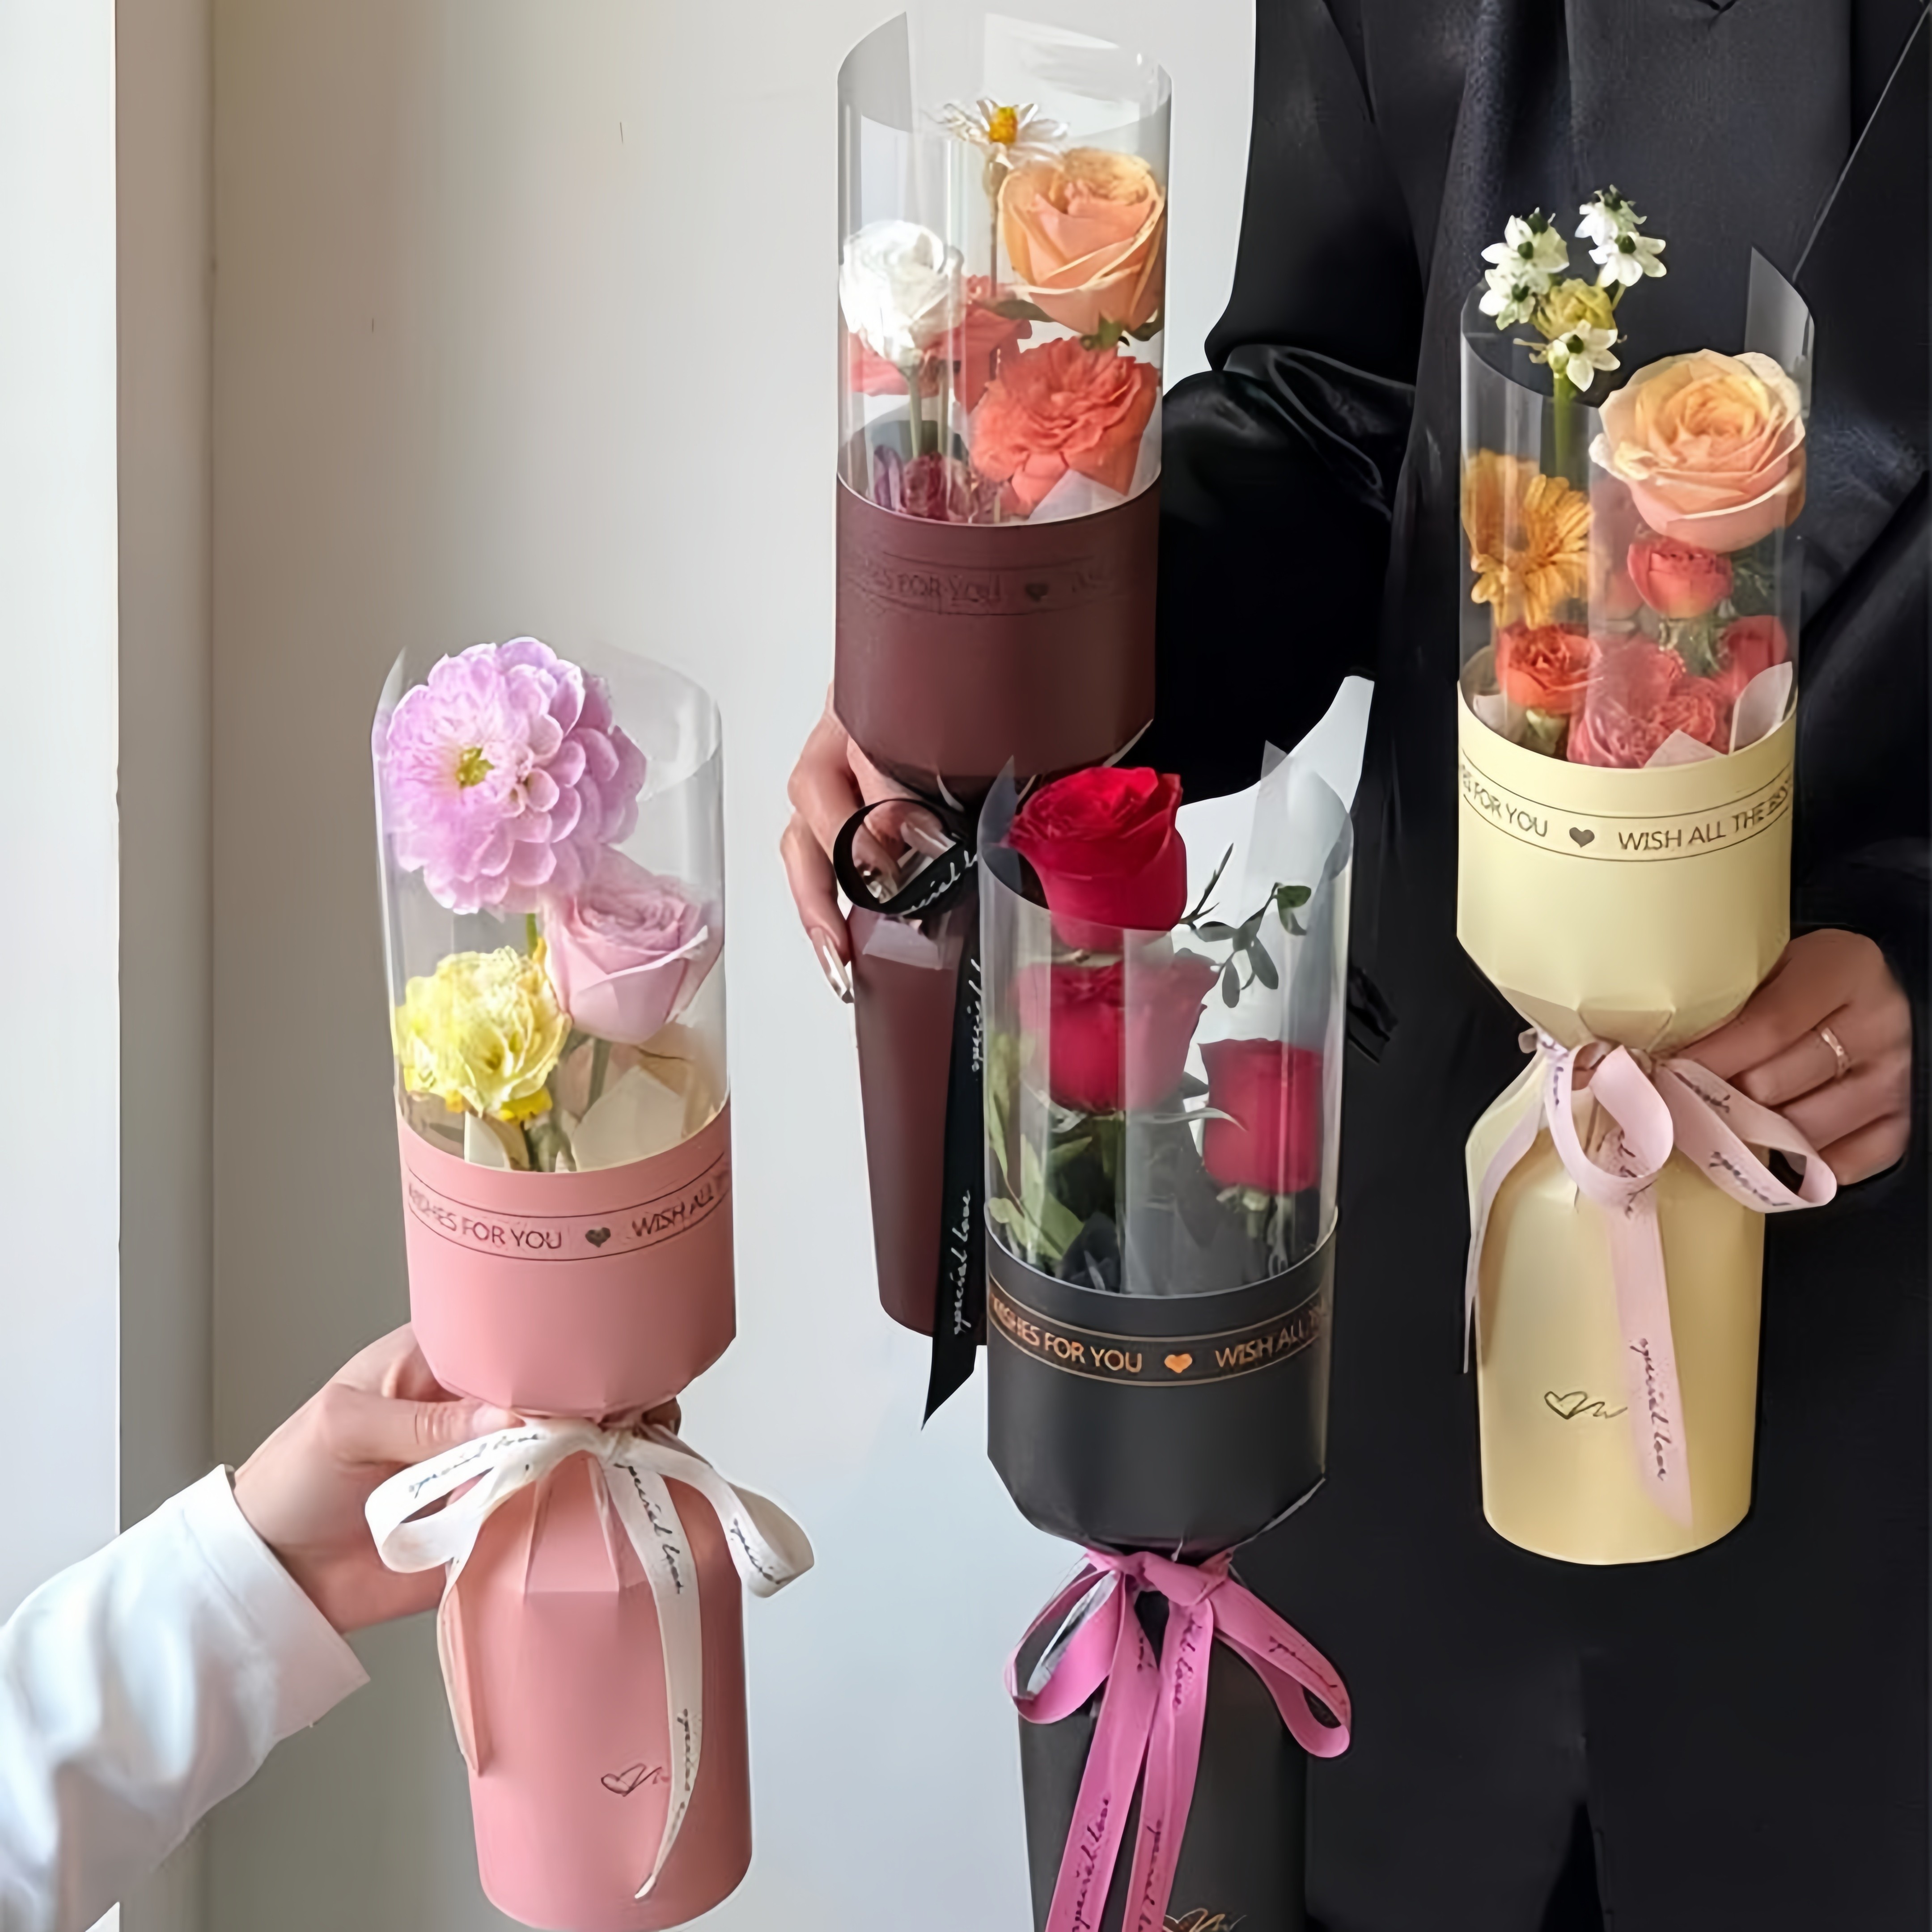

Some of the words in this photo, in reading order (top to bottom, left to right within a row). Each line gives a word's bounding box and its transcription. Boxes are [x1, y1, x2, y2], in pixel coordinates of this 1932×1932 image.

[1474, 781, 1502, 818] FOR
[1505, 803, 1548, 838] YOU
[1618, 829, 1682, 851] WISH
[1687, 820, 1727, 844] ALL
[462, 1216, 506, 1245] FOR
[510, 1227, 562, 1249] YOU
[1044, 1332, 1086, 1364] FOR
[1090, 1345, 1142, 1373] YOU
[1215, 1336, 1274, 1368] WISH
